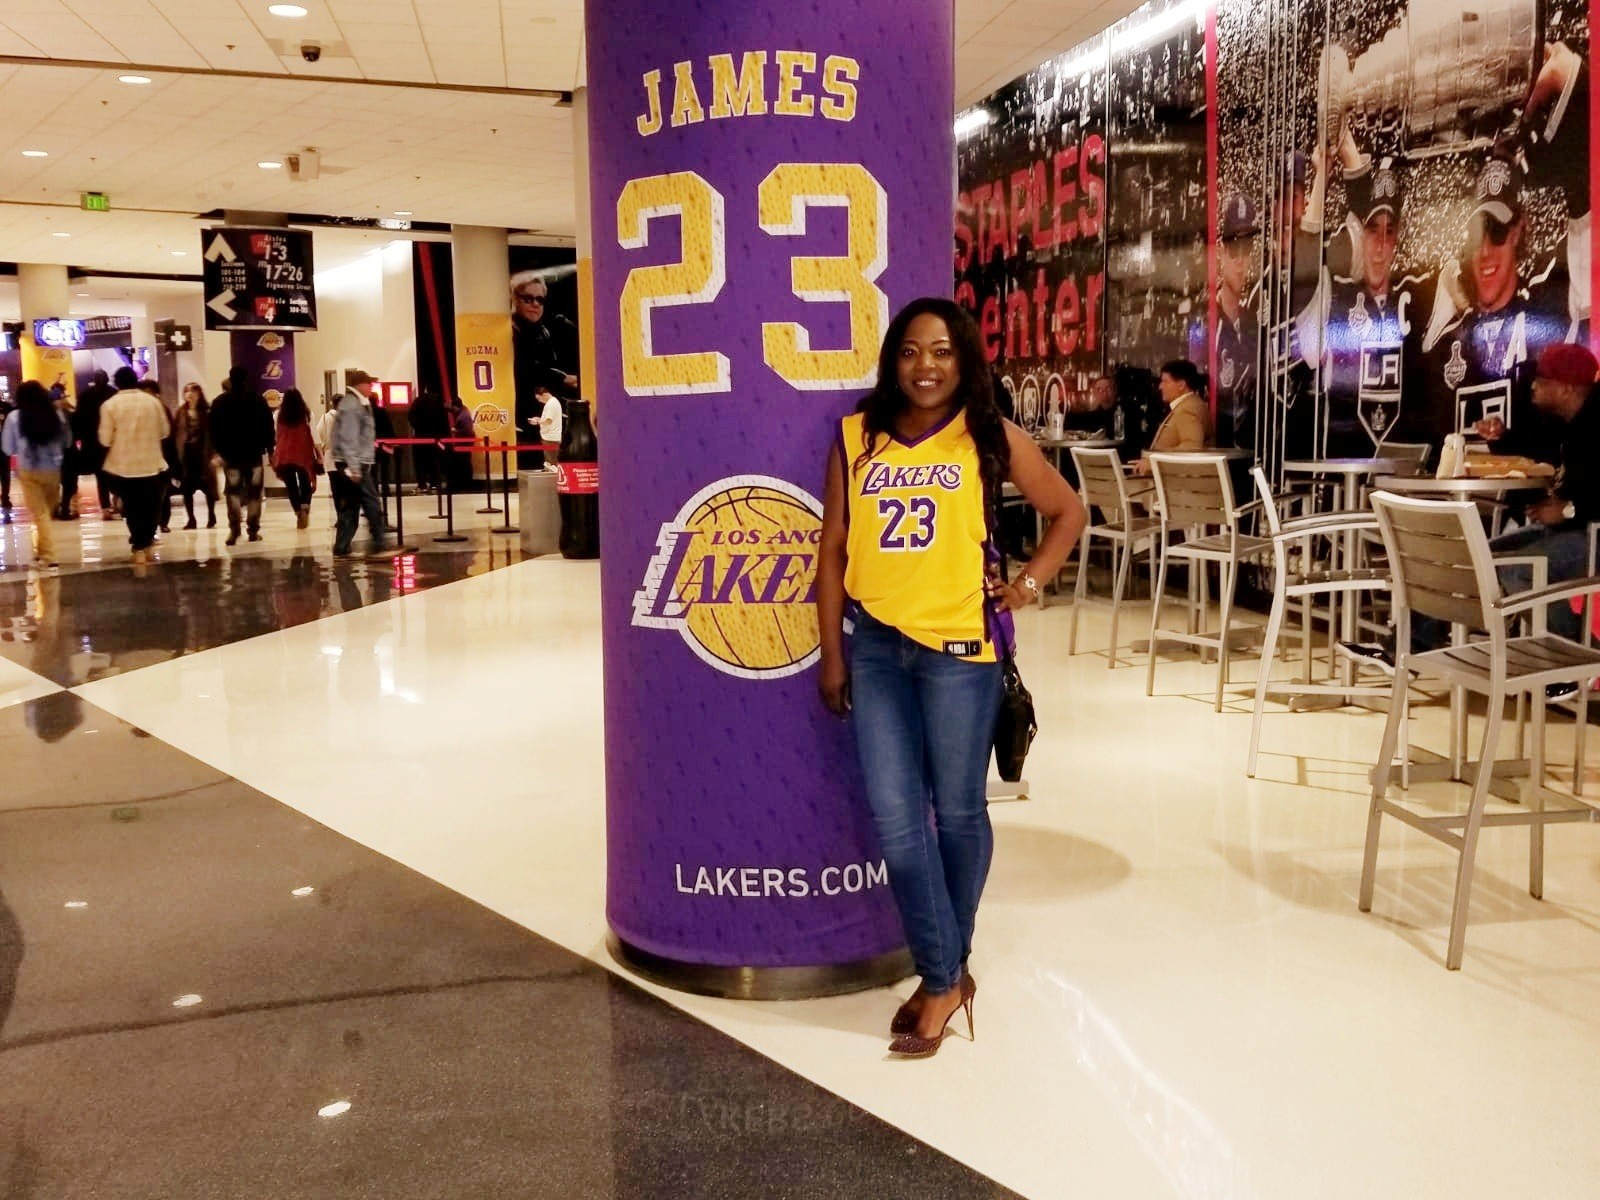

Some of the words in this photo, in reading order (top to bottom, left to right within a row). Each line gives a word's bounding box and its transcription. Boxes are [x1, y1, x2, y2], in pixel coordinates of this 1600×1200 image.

[636, 51, 860, 136] JAMES
[955, 133, 1105, 273] STAPLES
[265, 244, 287, 261] 1-3
[266, 264, 303, 281] 17-26
[616, 163, 890, 397] 23
[264, 307, 276, 323] 4
[466, 346, 499, 356] KUZMA
[1362, 353, 1399, 386] LA
[860, 462, 962, 497] LAKERS
[711, 529, 760, 545] LOS
[878, 496, 937, 553] 23
[675, 858, 889, 898] LAKERS.COM
